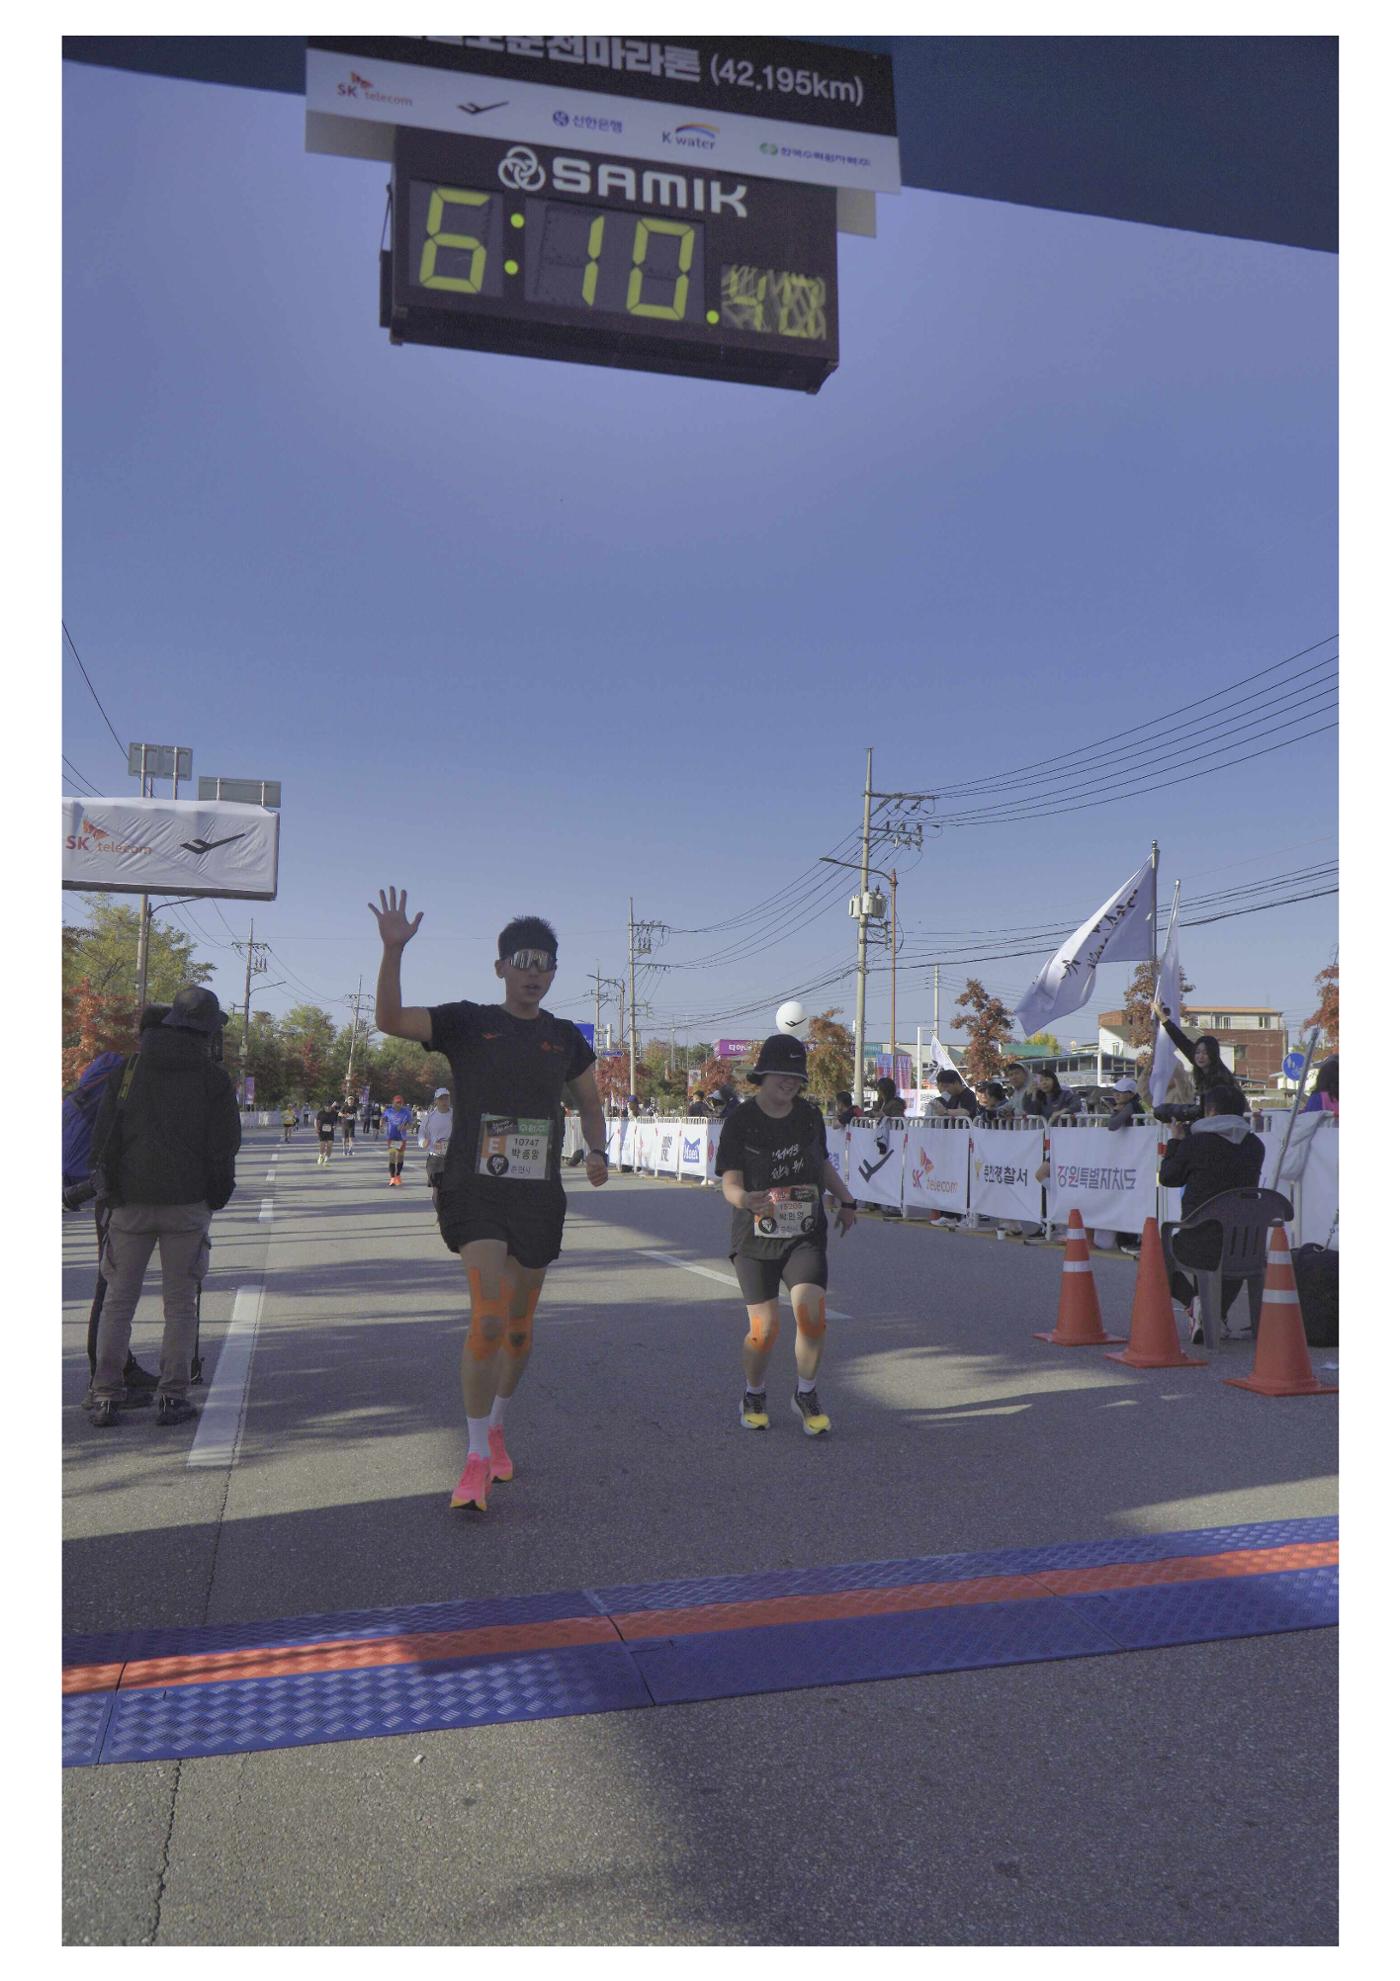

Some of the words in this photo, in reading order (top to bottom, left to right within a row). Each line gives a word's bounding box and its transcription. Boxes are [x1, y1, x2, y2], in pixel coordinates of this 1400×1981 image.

[337, 83, 358, 98] SK
[710, 53, 864, 107] (42.195km)
[552, 156, 748, 218] SAMIK
[65, 835, 89, 851] SK
[1057, 1165, 1137, 1190] 강원특별자치도
